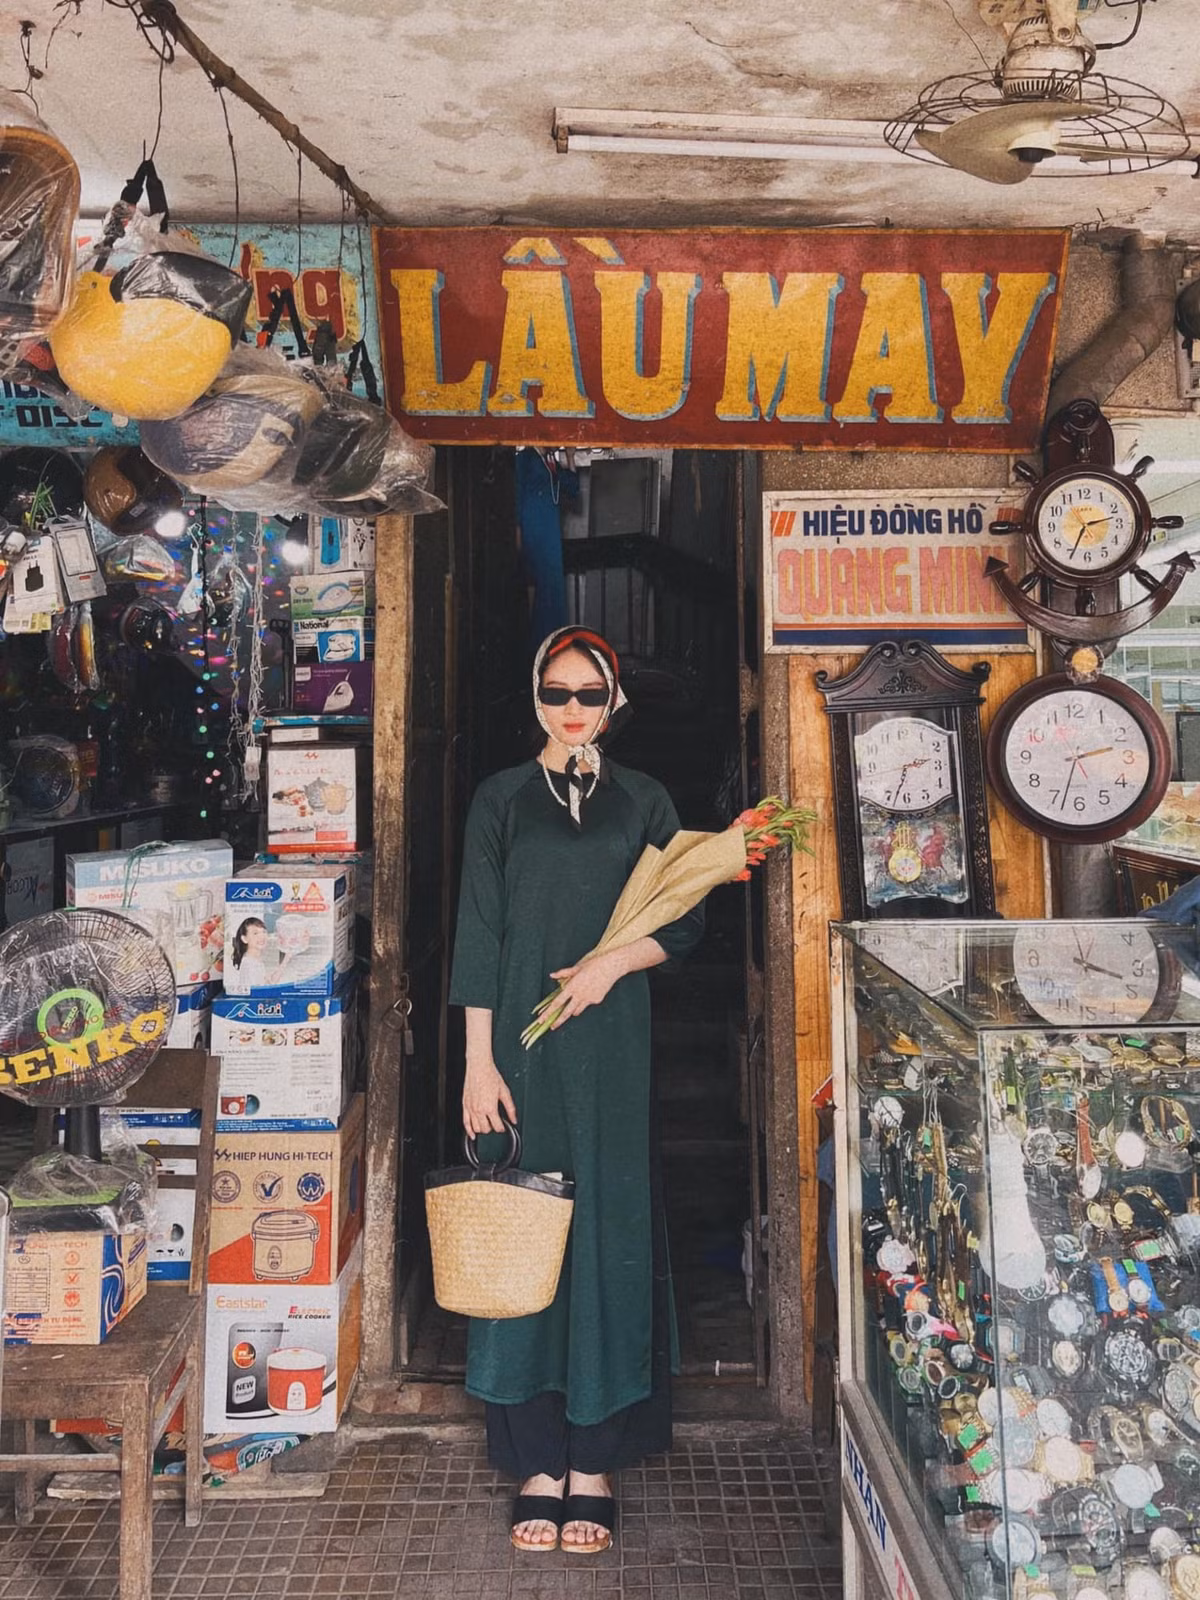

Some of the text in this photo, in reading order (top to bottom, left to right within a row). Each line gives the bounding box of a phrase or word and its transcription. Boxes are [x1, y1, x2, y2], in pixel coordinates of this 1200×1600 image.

[390, 237, 1056, 425] LẦU MAY
[1078, 488, 1091, 499] 12
[1100, 492, 1104, 502] 1
[1062, 494, 1072, 505] 11
[1050, 506, 1062, 517] 10
[1110, 503, 1118, 514] 2
[803, 503, 986, 544] HIỆU ĐỒNG HỒ
[1048, 522, 1056, 533] 9
[1116, 518, 1124, 530] 3
[1054, 538, 1062, 549] 8
[1111, 535, 1118, 545] 4
[1084, 552, 1092, 563] 6
[1101, 547, 1108, 558] 5
[778, 546, 1021, 621] QUANG MIN
[300, 621, 329, 629] National
[1064, 704, 1084, 718] 12
[1100, 710, 1104, 724] 1
[1028, 728, 1044, 742] 10
[1114, 727, 1127, 742] 2
[932, 742, 940, 752] 2
[1020, 750, 1032, 764] 9
[1122, 750, 1135, 764] 3
[868, 762, 876, 773] 9
[934, 760, 942, 771] 3
[935, 777, 942, 789] 4
[1028, 773, 1040, 788] 8
[1114, 773, 1128, 788] 4
[885, 790, 892, 801] 7
[902, 792, 911, 804] 6
[922, 789, 930, 800] 5
[1049, 790, 1060, 804] 7
[1098, 790, 1110, 805] 5
[1073, 796, 1086, 812] 6
[233, 1151, 333, 1161] HIEP HUNG HI-TECH
[216, 1295, 268, 1309] Eaststar
[236, 1381, 254, 1391] NEW
